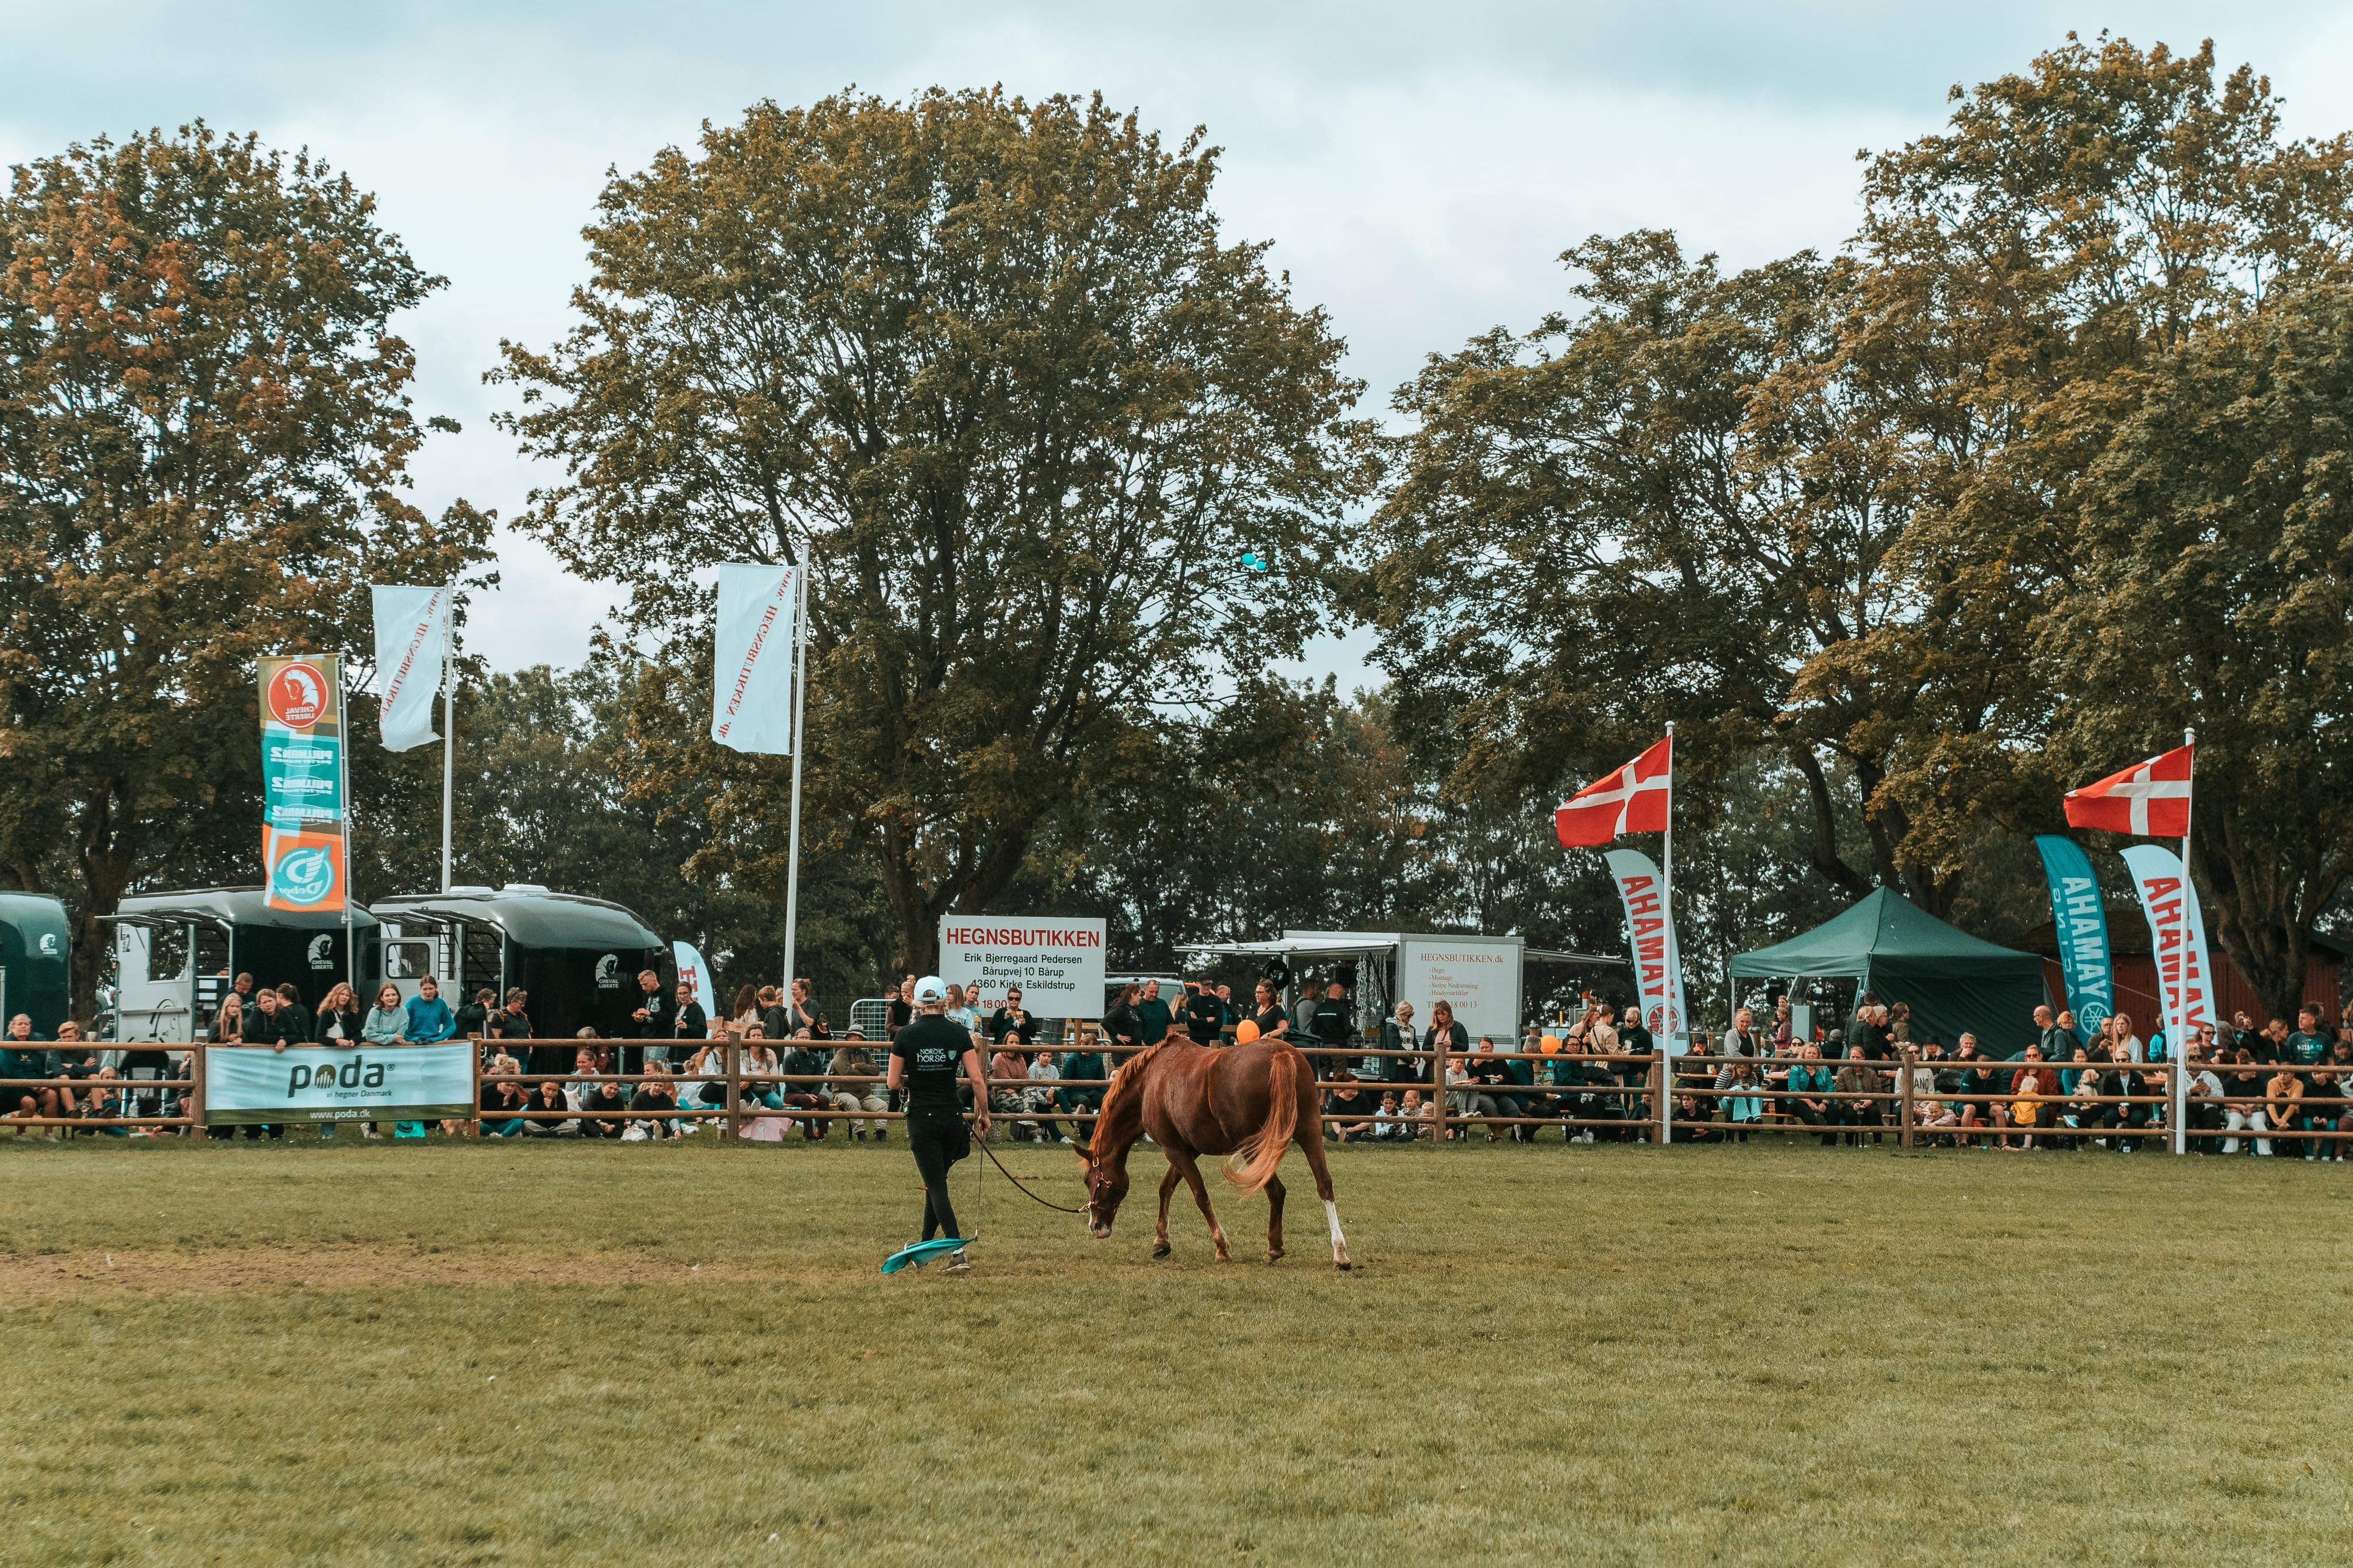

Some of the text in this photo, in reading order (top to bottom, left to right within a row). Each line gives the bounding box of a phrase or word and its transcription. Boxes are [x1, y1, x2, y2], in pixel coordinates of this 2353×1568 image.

[947, 928, 1100, 947] HEGNSBUTIKKEN
[964, 953, 1082, 965] Erik Bjerregaard Pedersen
[1421, 953, 1503, 963] HEGNSBUTIKKEN.dk
[982, 966, 1064, 978] Bårupvej 10 Bårup
[971, 979, 1075, 991] 4360 Kirke Eskildstrup
[335, 1091, 359, 1099] hegner
[310, 1109, 371, 1119] www.poda.dk
